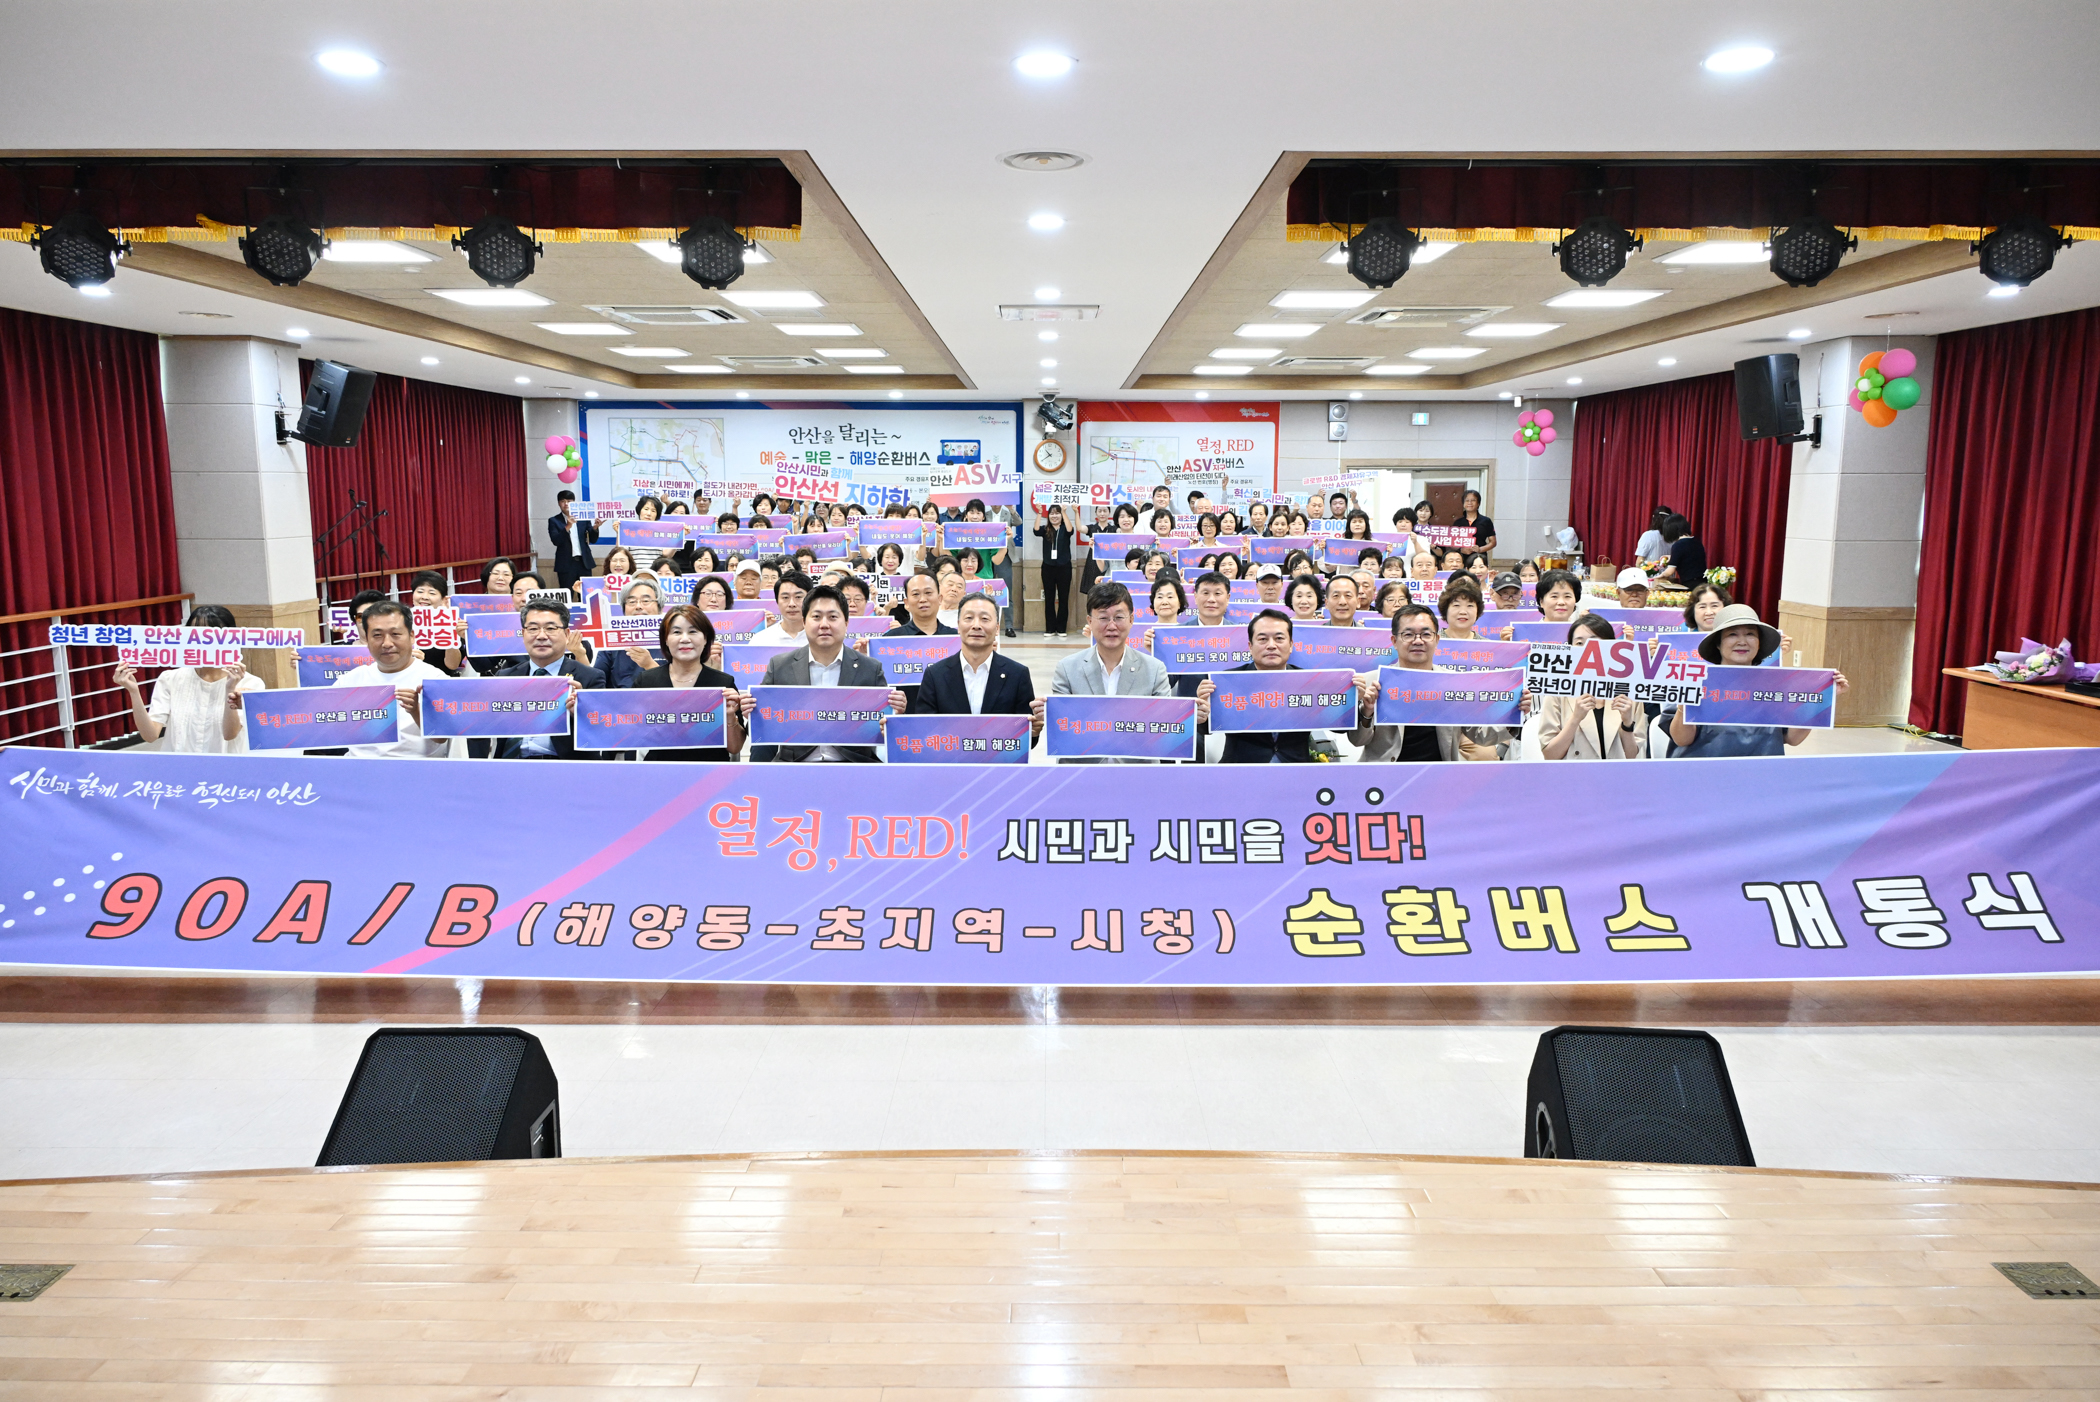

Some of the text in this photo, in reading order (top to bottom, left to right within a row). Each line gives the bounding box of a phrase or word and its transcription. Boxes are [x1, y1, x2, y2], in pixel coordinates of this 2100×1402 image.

[789, 427, 835, 444] 안산을
[1227, 439, 1254, 451] RED
[805, 451, 930, 465] 맑은 해양순환버스
[776, 462, 853, 480] 안산시민과 함께
[1182, 458, 1212, 472] ASV
[930, 464, 1021, 486] 안산 ASV 지구
[1303, 477, 1322, 485] 글로벌
[1341, 471, 1378, 481] 경제자유구역
[633, 479, 693, 489] 지상은 시민에게!
[775, 475, 839, 503] 안산선
[1035, 484, 1089, 494] 넓은 지상공간
[1336, 480, 1362, 488] ASV지구
[637, 489, 659, 497] 철도는
[1035, 494, 1079, 504] 개발 최적지
[1234, 488, 1260, 498] 혁신의
[1263, 489, 1271, 498] 길
[598, 511, 616, 519] 다시
[617, 510, 636, 518] 잇다!
[1239, 505, 1248, 515] 길
[1434, 537, 1475, 546] 사업 선정!
[1423, 581, 1443, 591] 꿈을
[413, 609, 457, 626] 해소!
[713, 621, 733, 630] 해양!
[1633, 624, 1682, 633] 안산을 달리다!
[51, 626, 302, 648] 청년 창업, 안산 ASV지구에서
[415, 629, 458, 646] 상승!
[1161, 637, 1187, 645] 오늘도
[1207, 637, 1230, 647] 해양!
[879, 646, 948, 658] 오늘도 함께 해양!
[1338, 645, 1363, 655] 안산을
[1364, 647, 1392, 656] 달리다!
[1470, 651, 1493, 662] 해양!
[121, 648, 240, 667] 현실이 됩니다
[307, 654, 332, 664] 오늘도
[1176, 652, 1228, 663] 내일도 웃어
[1529, 639, 1706, 683] 안산 ASV 지구
[893, 663, 923, 674] 내일도
[1444, 691, 1476, 702] 안산을
[1479, 690, 1514, 702] 달리다!
[1527, 676, 1702, 705] 청년의 미래를 연결하다
[1220, 691, 1346, 711] 명품 해양! 함께 해양!
[1753, 691, 1784, 703] 안산을
[1788, 691, 1823, 704] 달리다!
[492, 700, 523, 713] 안산을
[527, 699, 559, 712] 달리다!
[315, 711, 347, 724] 안산을
[351, 708, 388, 722] 달리다!
[646, 712, 677, 725] 안산을
[680, 712, 715, 724] 달리다!
[817, 710, 847, 722] 안산을
[851, 709, 884, 722] 달리다!
[1114, 721, 1146, 733] 안산을
[1149, 721, 1185, 734] 달리다!
[896, 734, 1021, 753] 명품 해양! 함께 해양!
[10, 767, 74, 799] 시민과
[123, 781, 186, 809] 자유로운
[191, 782, 260, 809] 혁신도시
[266, 782, 321, 806] 안산
[998, 817, 1135, 865] 시민과
[1150, 817, 1285, 865] 시민을
[1302, 812, 1427, 866] 잇다!
[1282, 882, 1692, 958] 순환버스
[1741, 870, 2066, 951] 개통식
